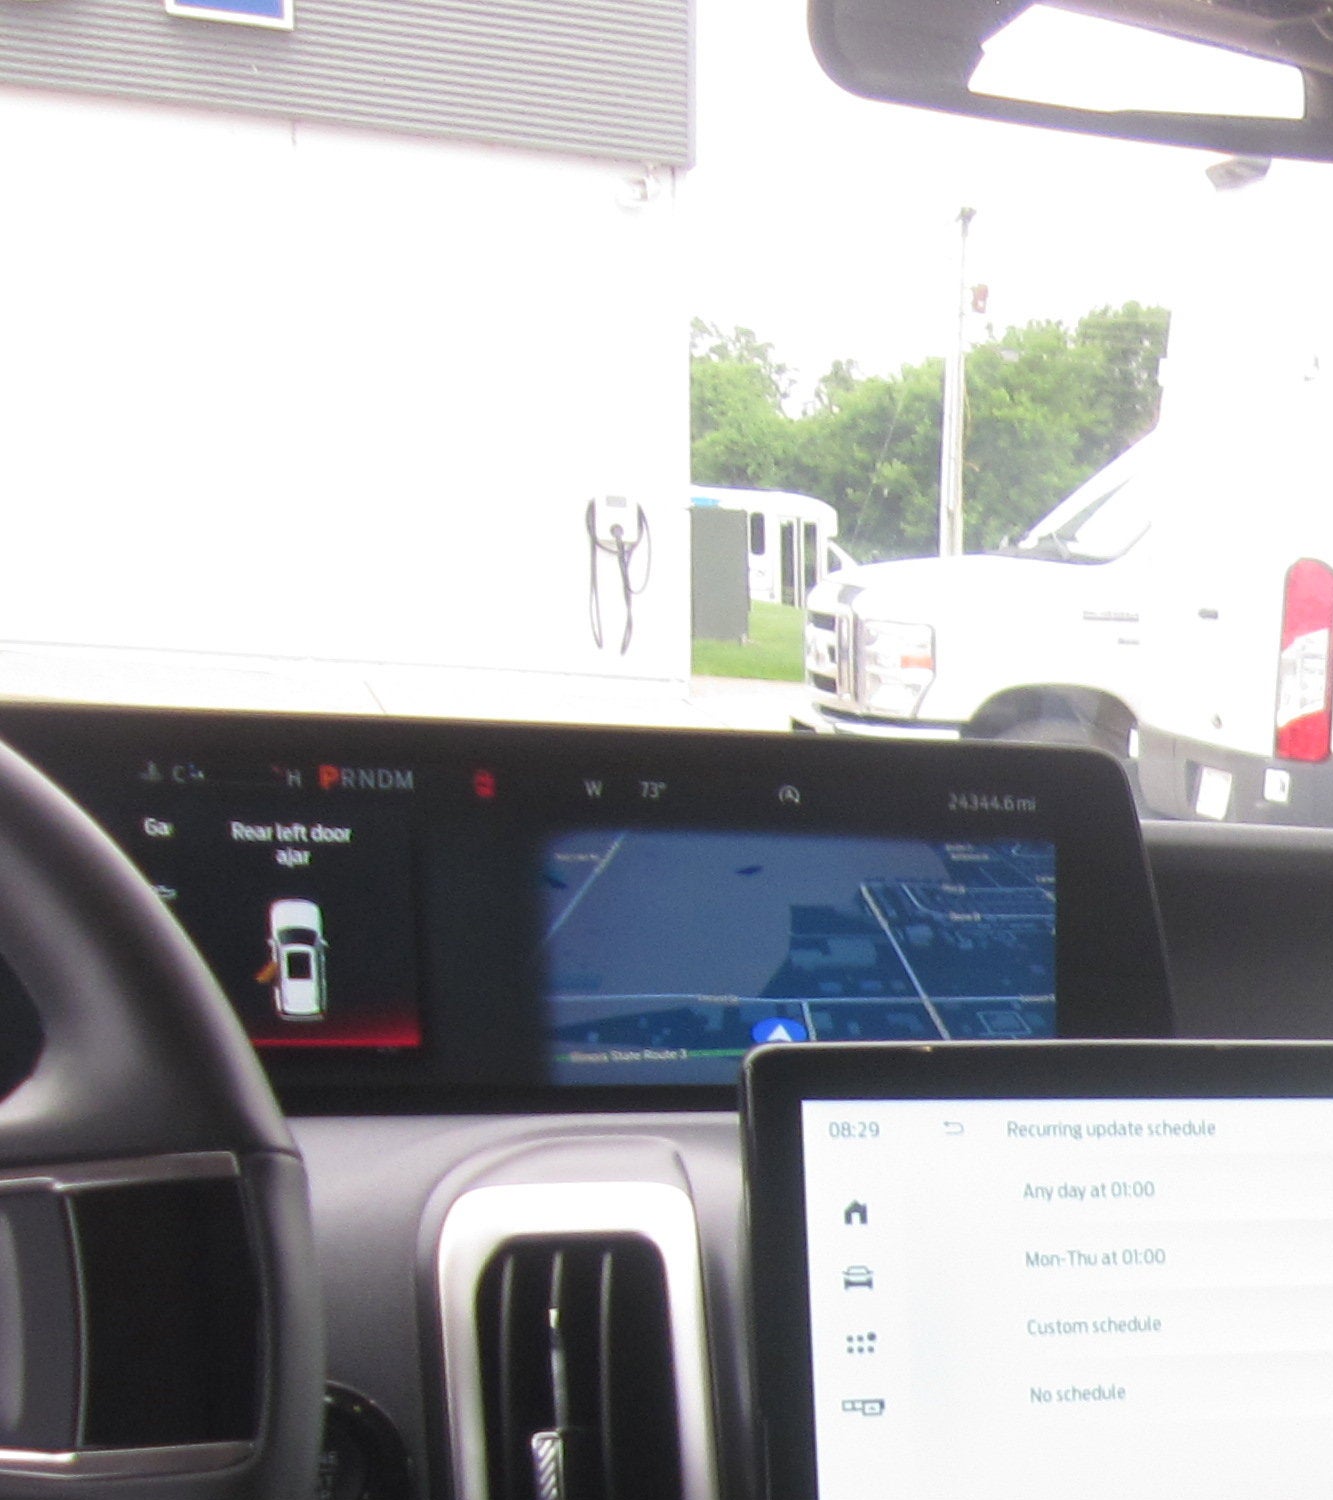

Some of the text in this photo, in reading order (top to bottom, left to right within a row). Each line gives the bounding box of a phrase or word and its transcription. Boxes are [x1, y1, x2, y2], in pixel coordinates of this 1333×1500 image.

[230, 821, 352, 843] Rear left door
[275, 847, 311, 867] ajar
[829, 1121, 880, 1139] 08:29
[1007, 1119, 1216, 1140] Recurring update schedule
[1023, 1180, 1155, 1202] Any day at 01:00
[1025, 1248, 1166, 1268] Mon-Thu at 01:00
[1027, 1315, 1162, 1336] Custom schedule
[1030, 1384, 1126, 1404] No schedule
